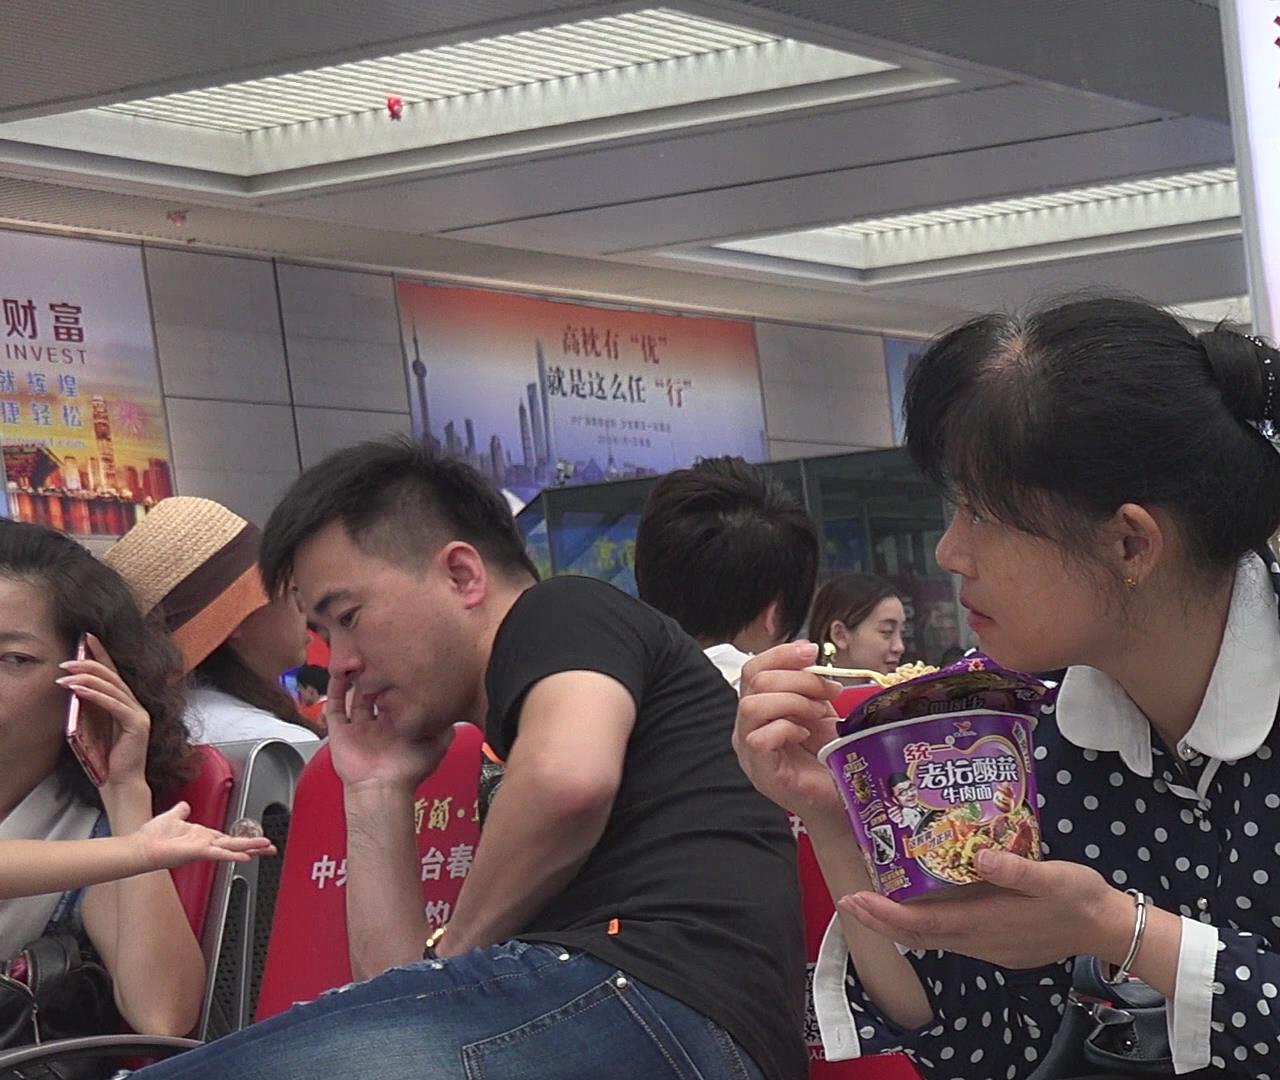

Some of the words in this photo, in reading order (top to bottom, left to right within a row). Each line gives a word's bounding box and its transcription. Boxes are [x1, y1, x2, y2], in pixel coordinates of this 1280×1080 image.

[2, 299, 84, 342] 财富
[5, 343, 88, 365] INVEST
[918, 757, 1019, 790] 老坛酸菜
[943, 783, 993, 804] 牛肉面
